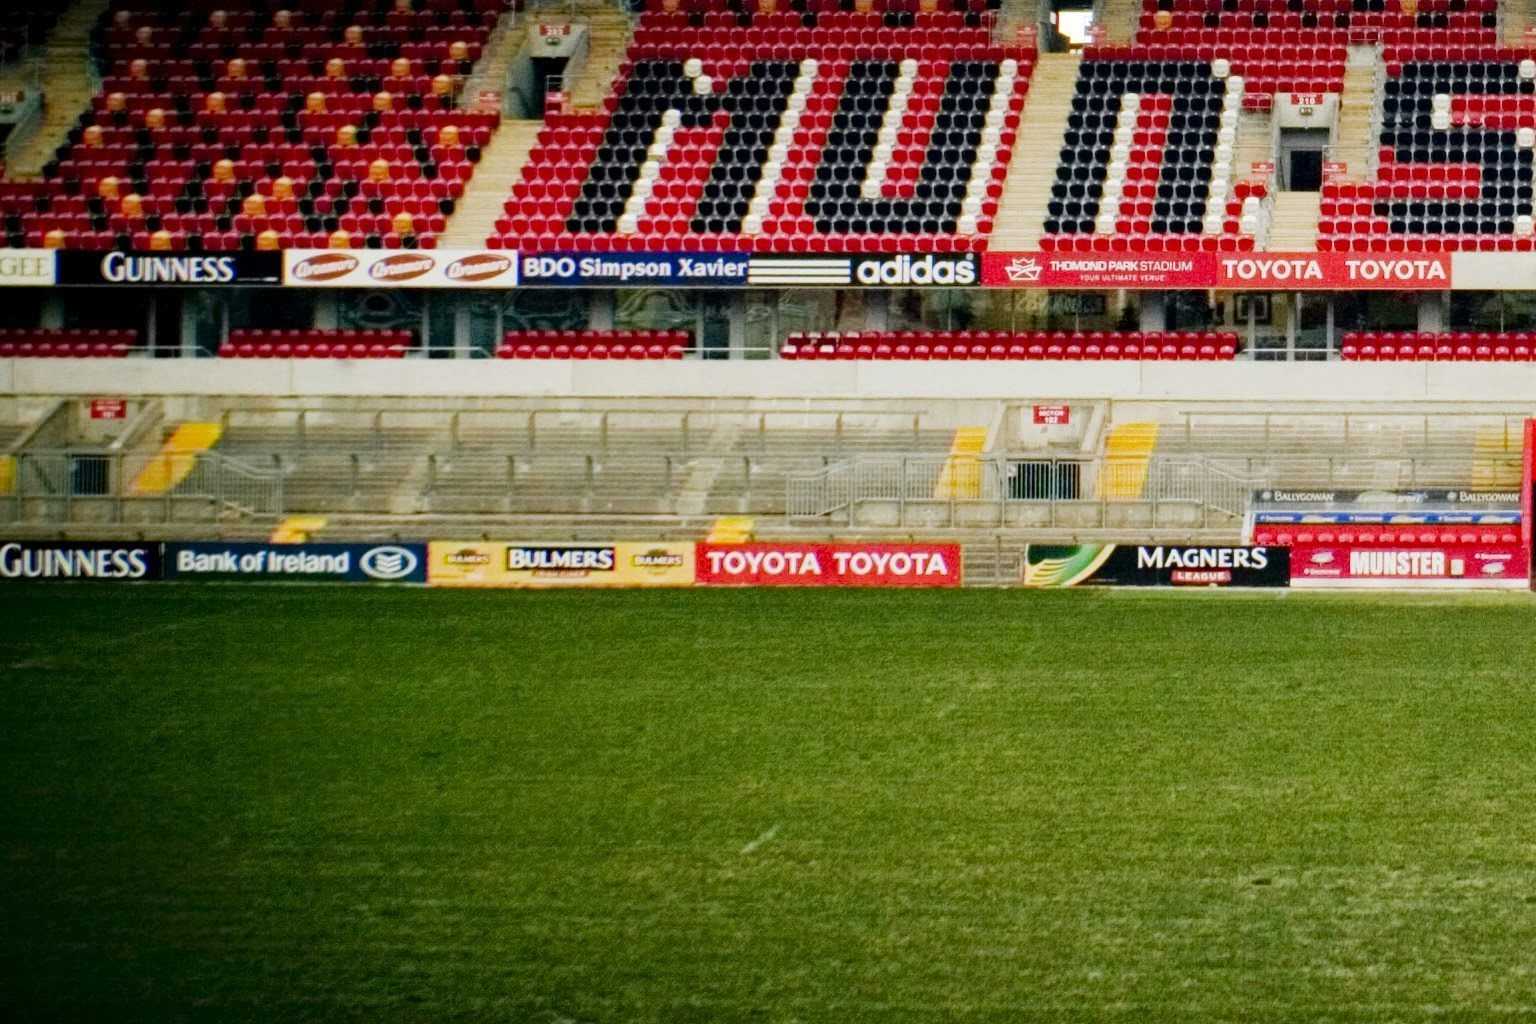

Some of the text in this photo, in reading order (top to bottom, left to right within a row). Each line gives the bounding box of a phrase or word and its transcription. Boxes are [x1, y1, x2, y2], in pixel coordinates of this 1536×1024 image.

[102, 251, 235, 282] GUINNESS
[524, 257, 747, 280] BDO Simpson Xavier
[856, 255, 975, 284] adidas
[1050, 261, 1192, 272] THOMOND PARK STADIUM
[1222, 260, 1446, 280] TOYOTA TOYOTA
[1102, 274, 1137, 282] ULTIMATE
[1274, 491, 1334, 501] BALLYGOWAN
[1460, 491, 1519, 501] BALLYGOWAN
[0, 543, 148, 577] GUINNESS
[178, 550, 350, 573] Bank of Ireland
[509, 549, 614, 569] BULMERS
[707, 552, 948, 576] TOYOTA TOYOTA
[1137, 547, 1268, 569] MAGNERS
[1350, 551, 1445, 575] MUNSTER
[1177, 571, 1225, 581] LEAGUE
